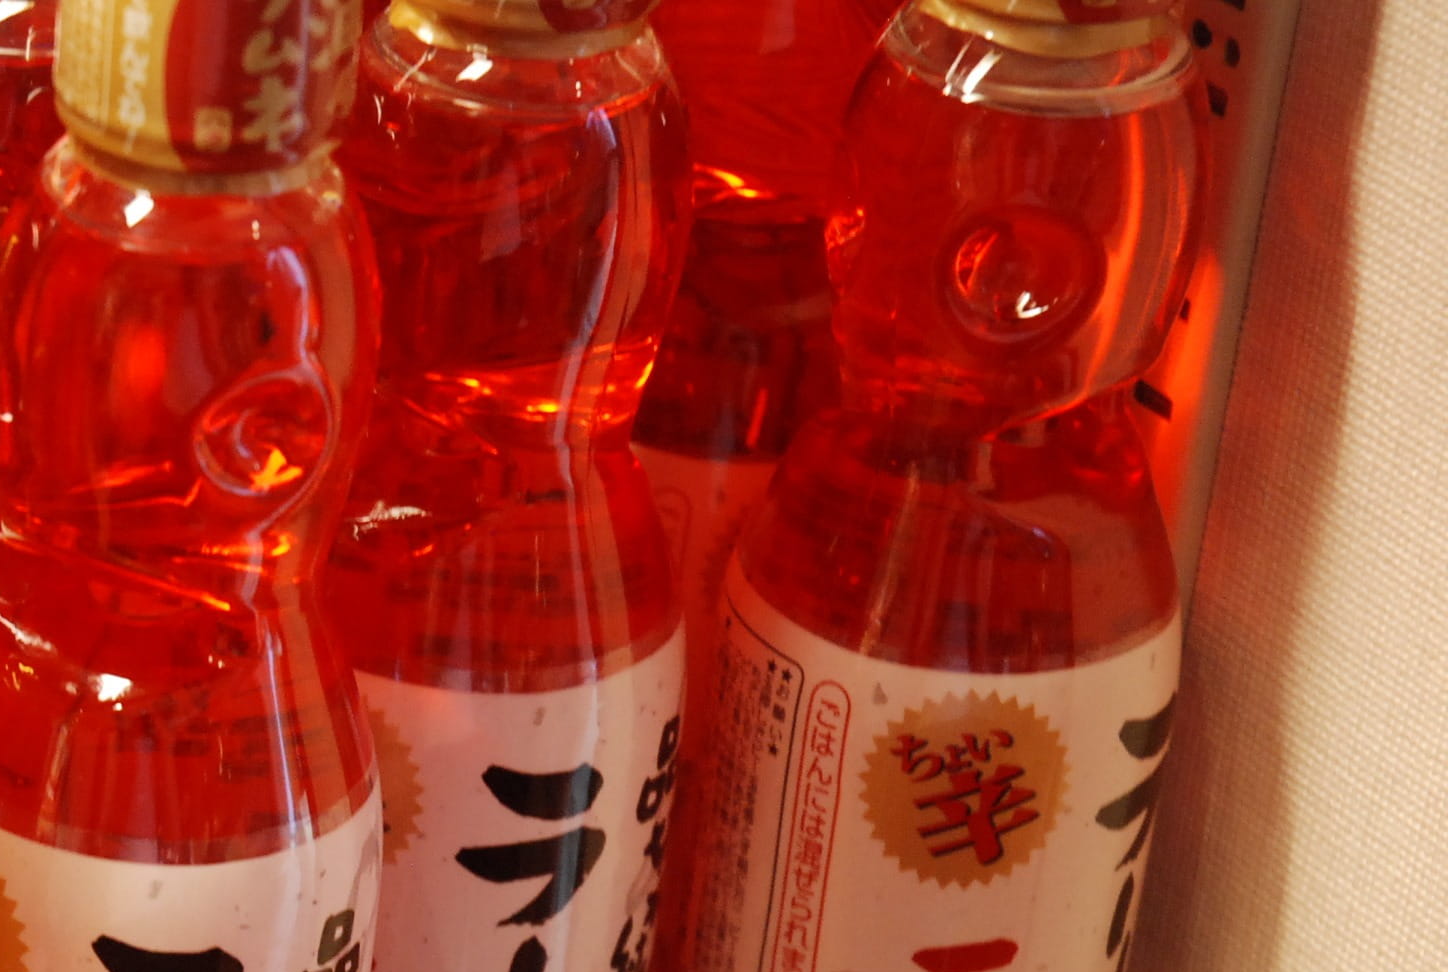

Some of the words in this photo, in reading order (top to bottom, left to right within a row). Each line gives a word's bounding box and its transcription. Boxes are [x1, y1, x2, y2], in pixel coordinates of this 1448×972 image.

[889, 728, 1014, 783] ちょい
[913, 764, 1040, 865] 辛
